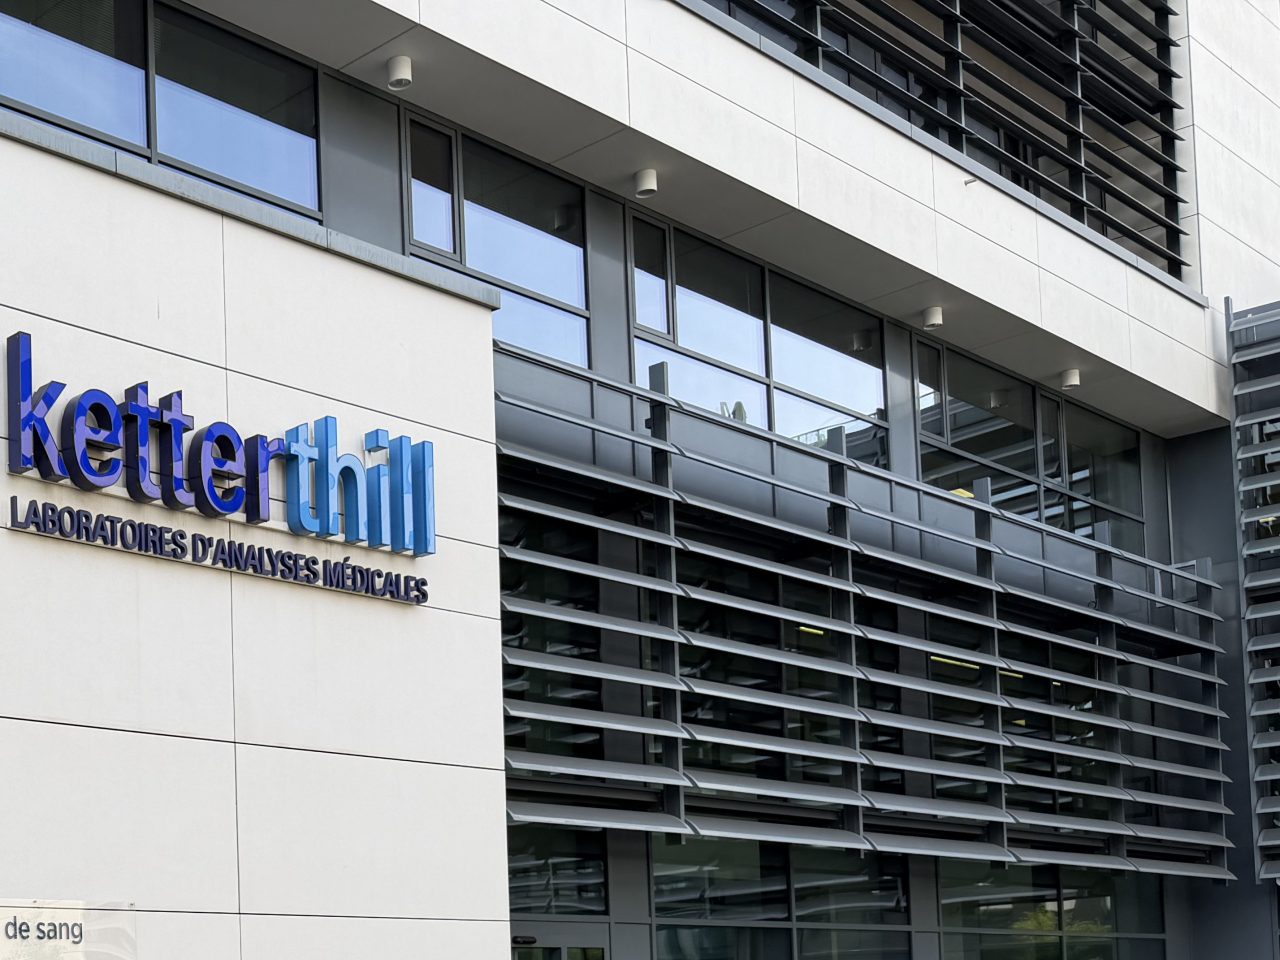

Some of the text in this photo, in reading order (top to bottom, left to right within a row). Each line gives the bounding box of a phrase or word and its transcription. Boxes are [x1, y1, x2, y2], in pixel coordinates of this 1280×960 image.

[6, 331, 436, 557] ketterthill
[10, 495, 429, 605] LABORATOIRES D'ANALYSES MÉDICALES
[5, 915, 30, 940] de
[36, 921, 84, 945] sang
